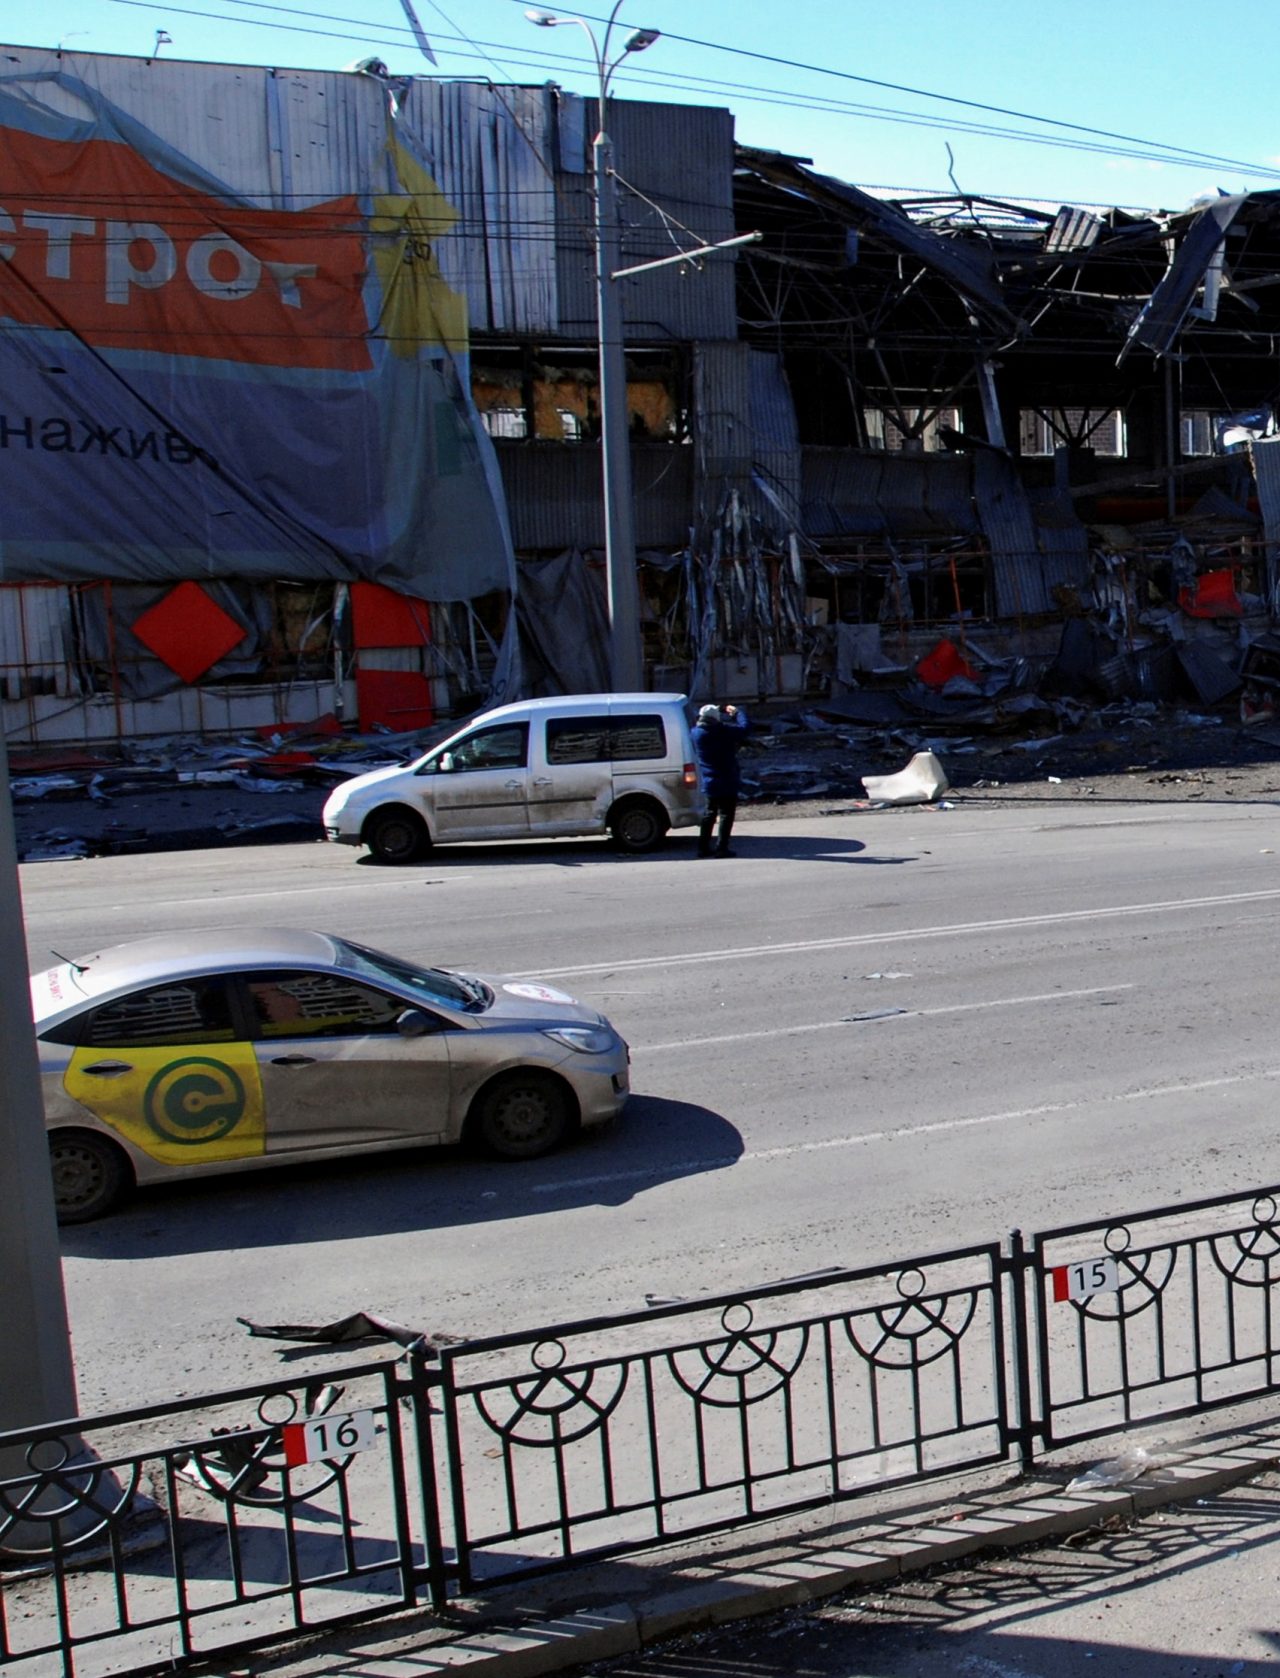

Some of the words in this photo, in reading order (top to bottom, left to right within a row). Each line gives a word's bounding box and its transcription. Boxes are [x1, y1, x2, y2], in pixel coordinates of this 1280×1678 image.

[0, 414, 218, 469] нажив
[1074, 1262, 1106, 1291] 15
[313, 1417, 359, 1452] 16
